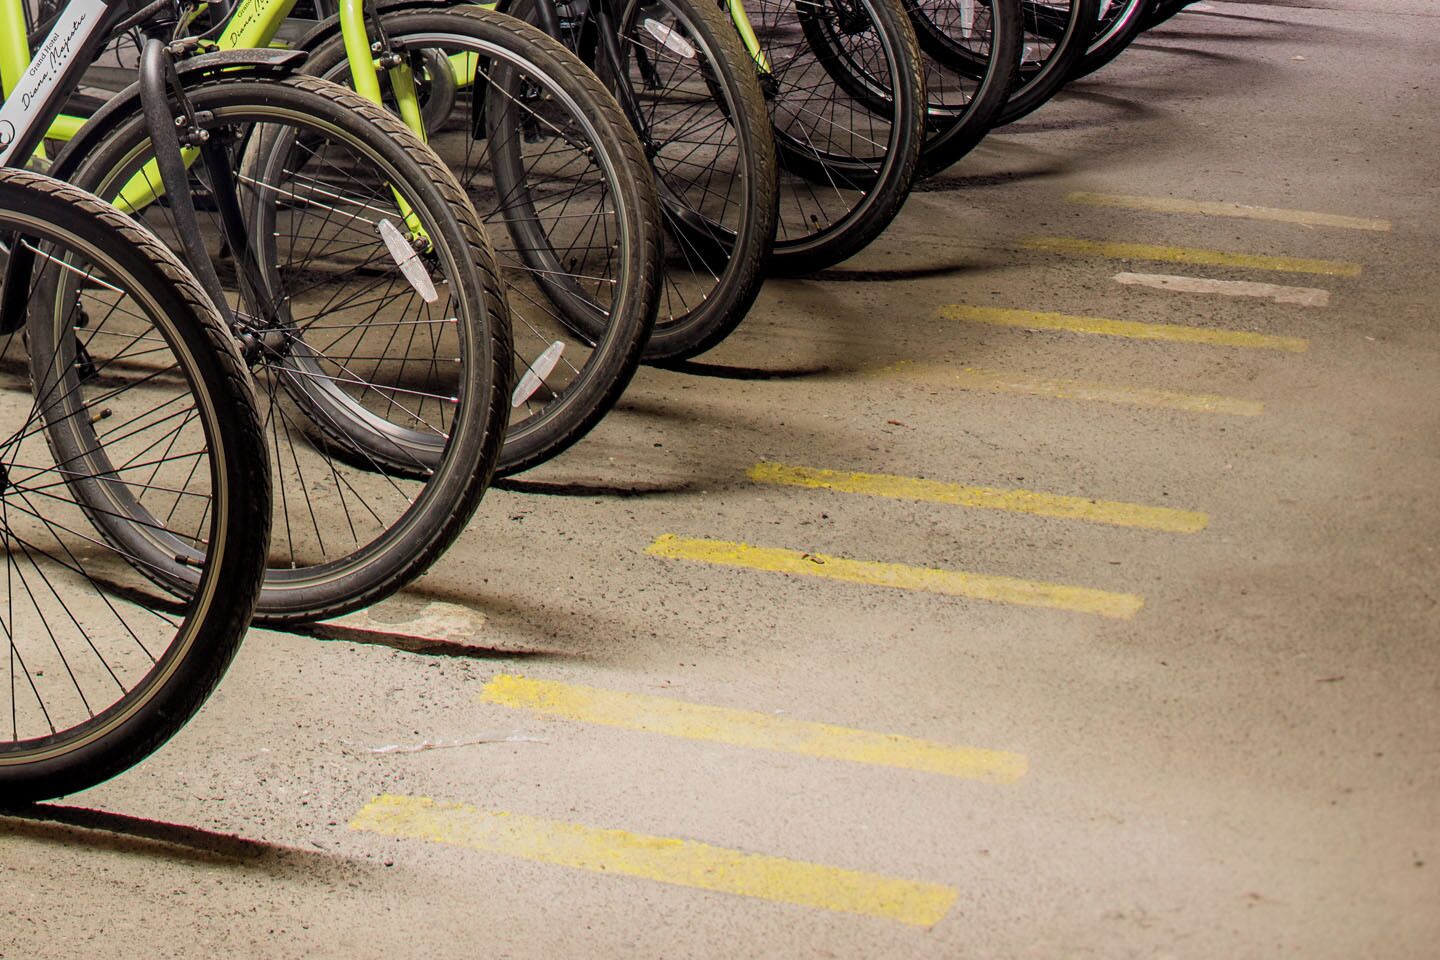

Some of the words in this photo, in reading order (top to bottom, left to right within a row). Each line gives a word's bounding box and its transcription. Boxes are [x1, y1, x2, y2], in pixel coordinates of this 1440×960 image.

[22, 71, 49, 111] Diana
[50, 13, 86, 69] Majestic
[29, 53, 46, 76] Grand
[45, 32, 60, 55] Hotel
